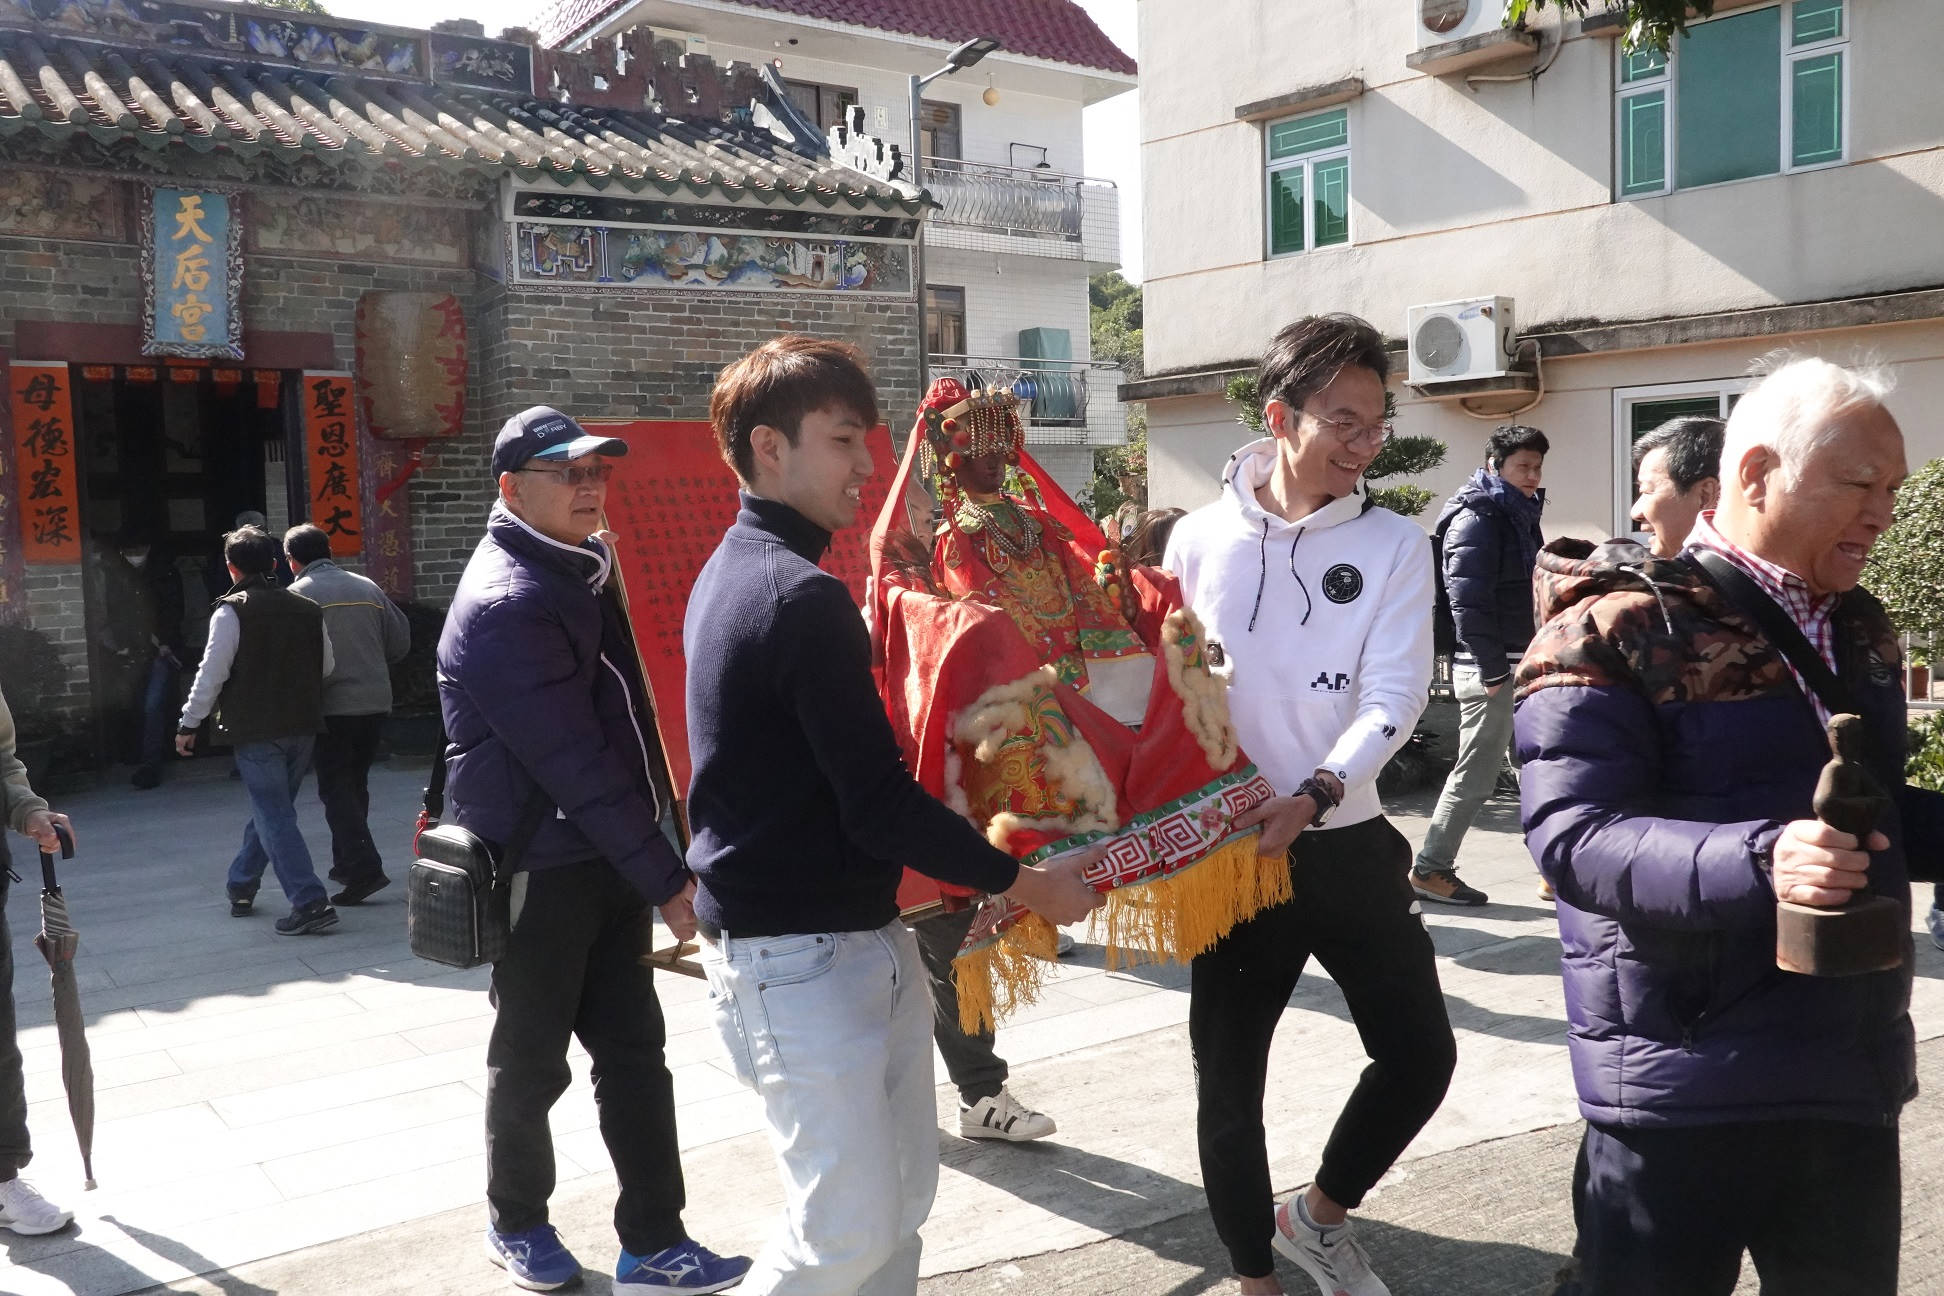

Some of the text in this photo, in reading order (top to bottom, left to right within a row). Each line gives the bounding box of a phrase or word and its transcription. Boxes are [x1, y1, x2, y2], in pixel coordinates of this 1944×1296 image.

[171, 194, 214, 342] 天后宮
[16, 372, 73, 547] 母德宏深
[311, 378, 360, 537] 聖恩廣大
